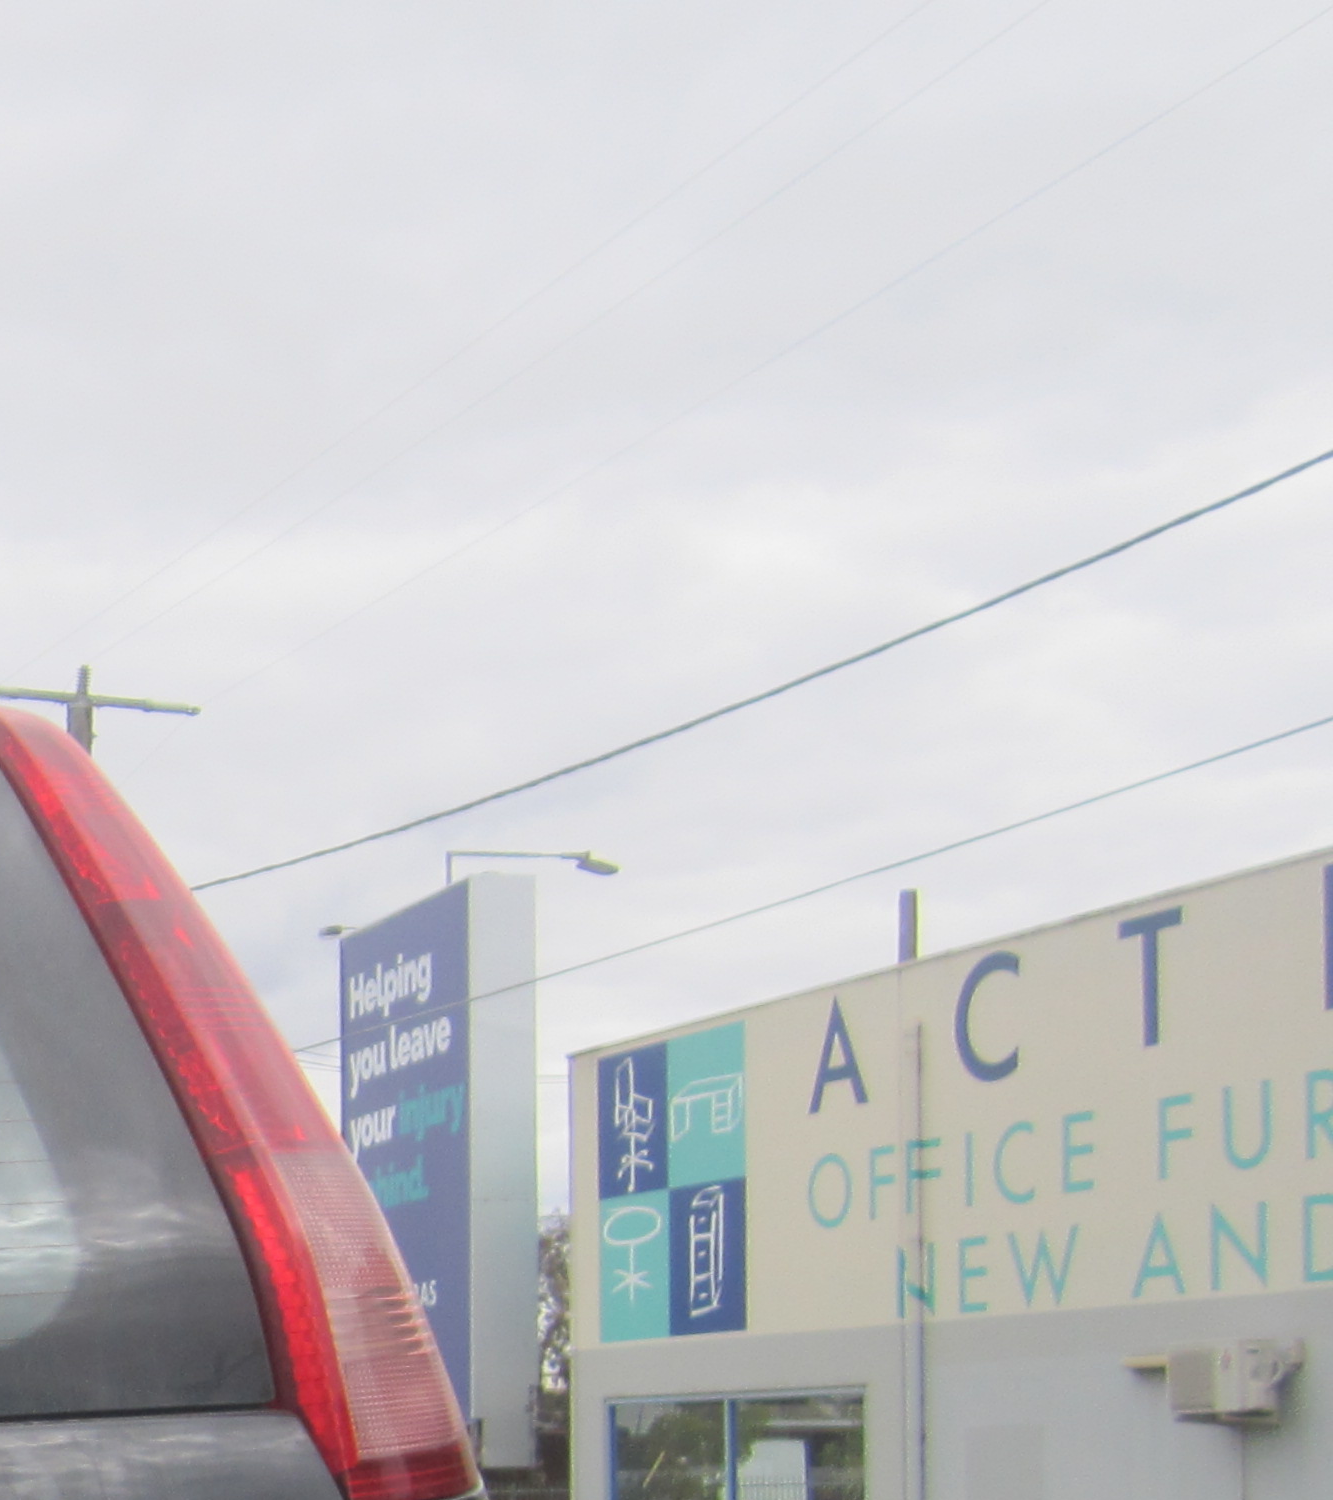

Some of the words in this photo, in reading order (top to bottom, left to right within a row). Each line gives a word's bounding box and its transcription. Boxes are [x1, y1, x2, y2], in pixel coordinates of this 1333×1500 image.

[349, 952, 433, 1020] Helping
[349, 1041, 386, 1099] you
[389, 1016, 452, 1070] leave
[349, 1105, 396, 1163] your
[808, 1110, 1095, 1230] OFFICE
[895, 1223, 1080, 1319] NEW
